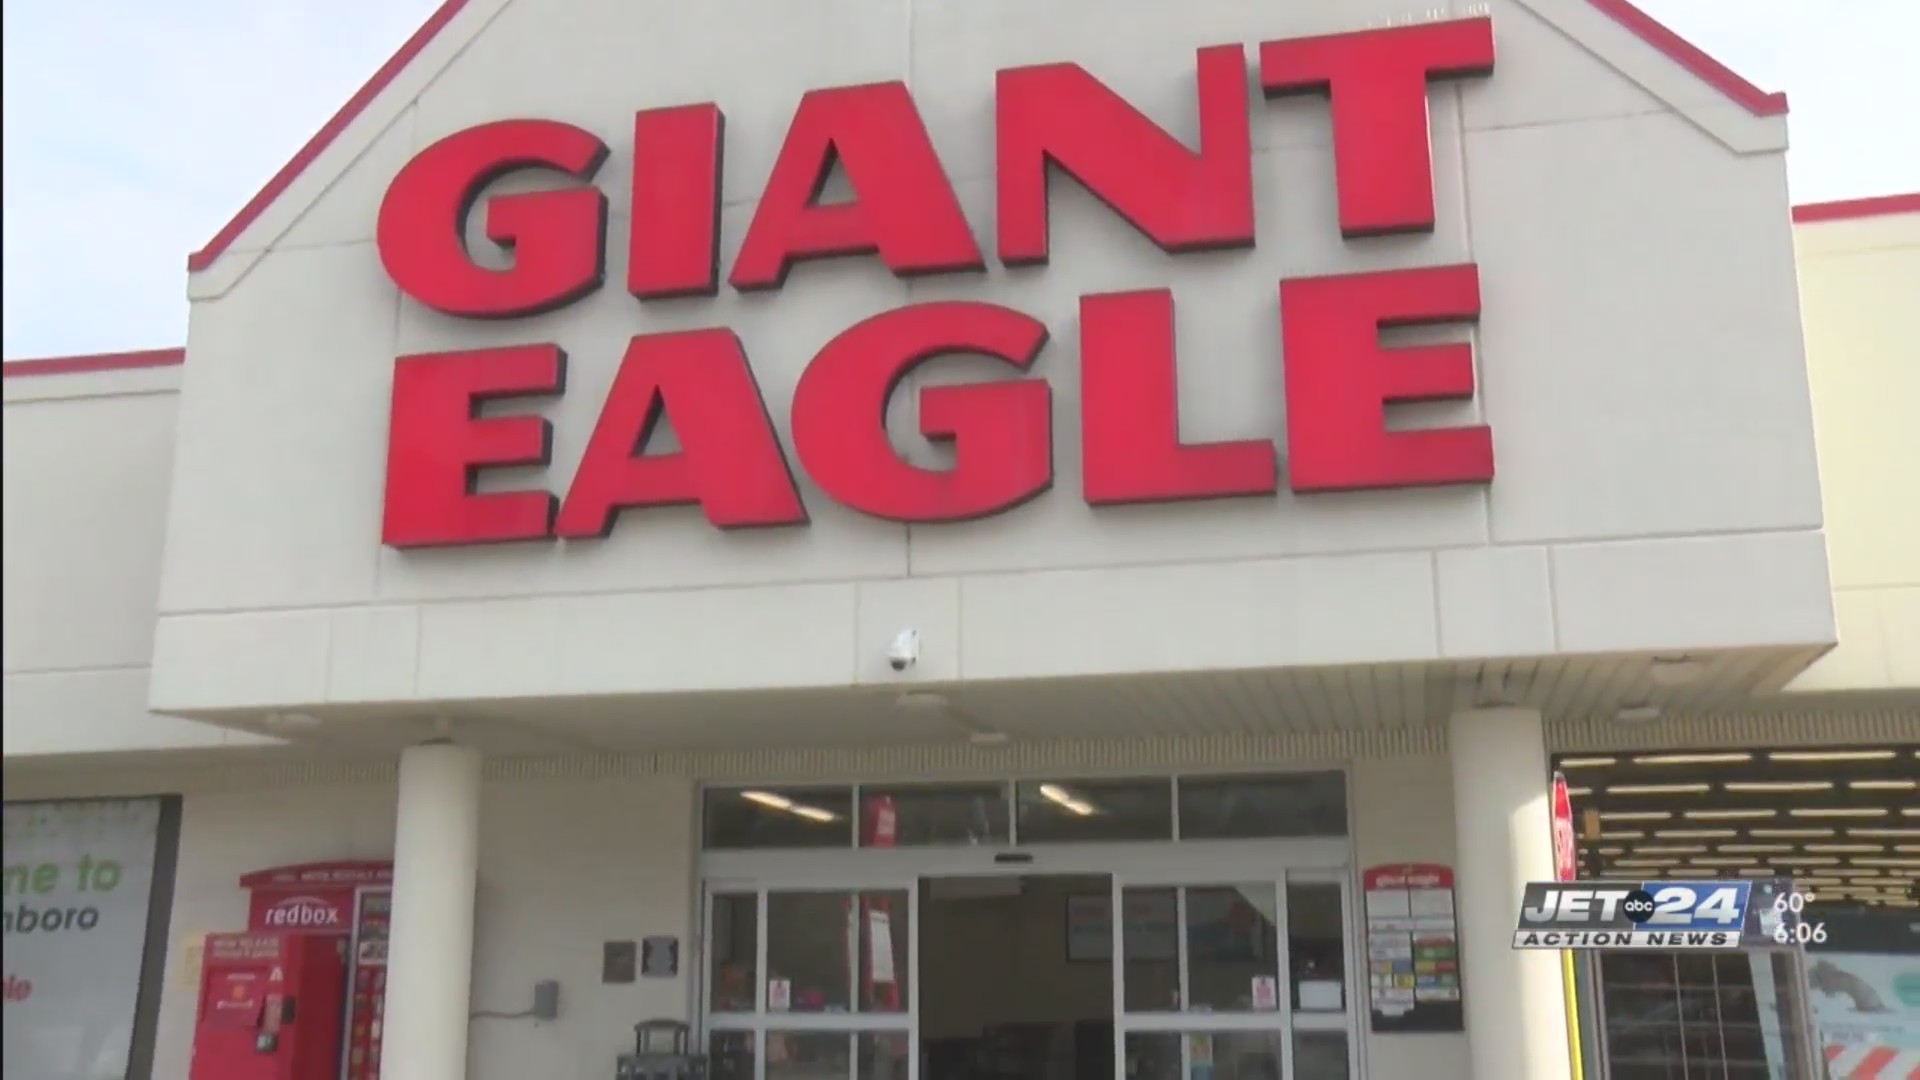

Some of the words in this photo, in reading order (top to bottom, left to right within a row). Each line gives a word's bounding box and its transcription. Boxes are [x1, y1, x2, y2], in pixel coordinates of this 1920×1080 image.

[377, 16, 1495, 319] GIANT
[381, 263, 1495, 549] EAGLE
[77, 853, 121, 893] to
[265, 904, 339, 926] redbox
